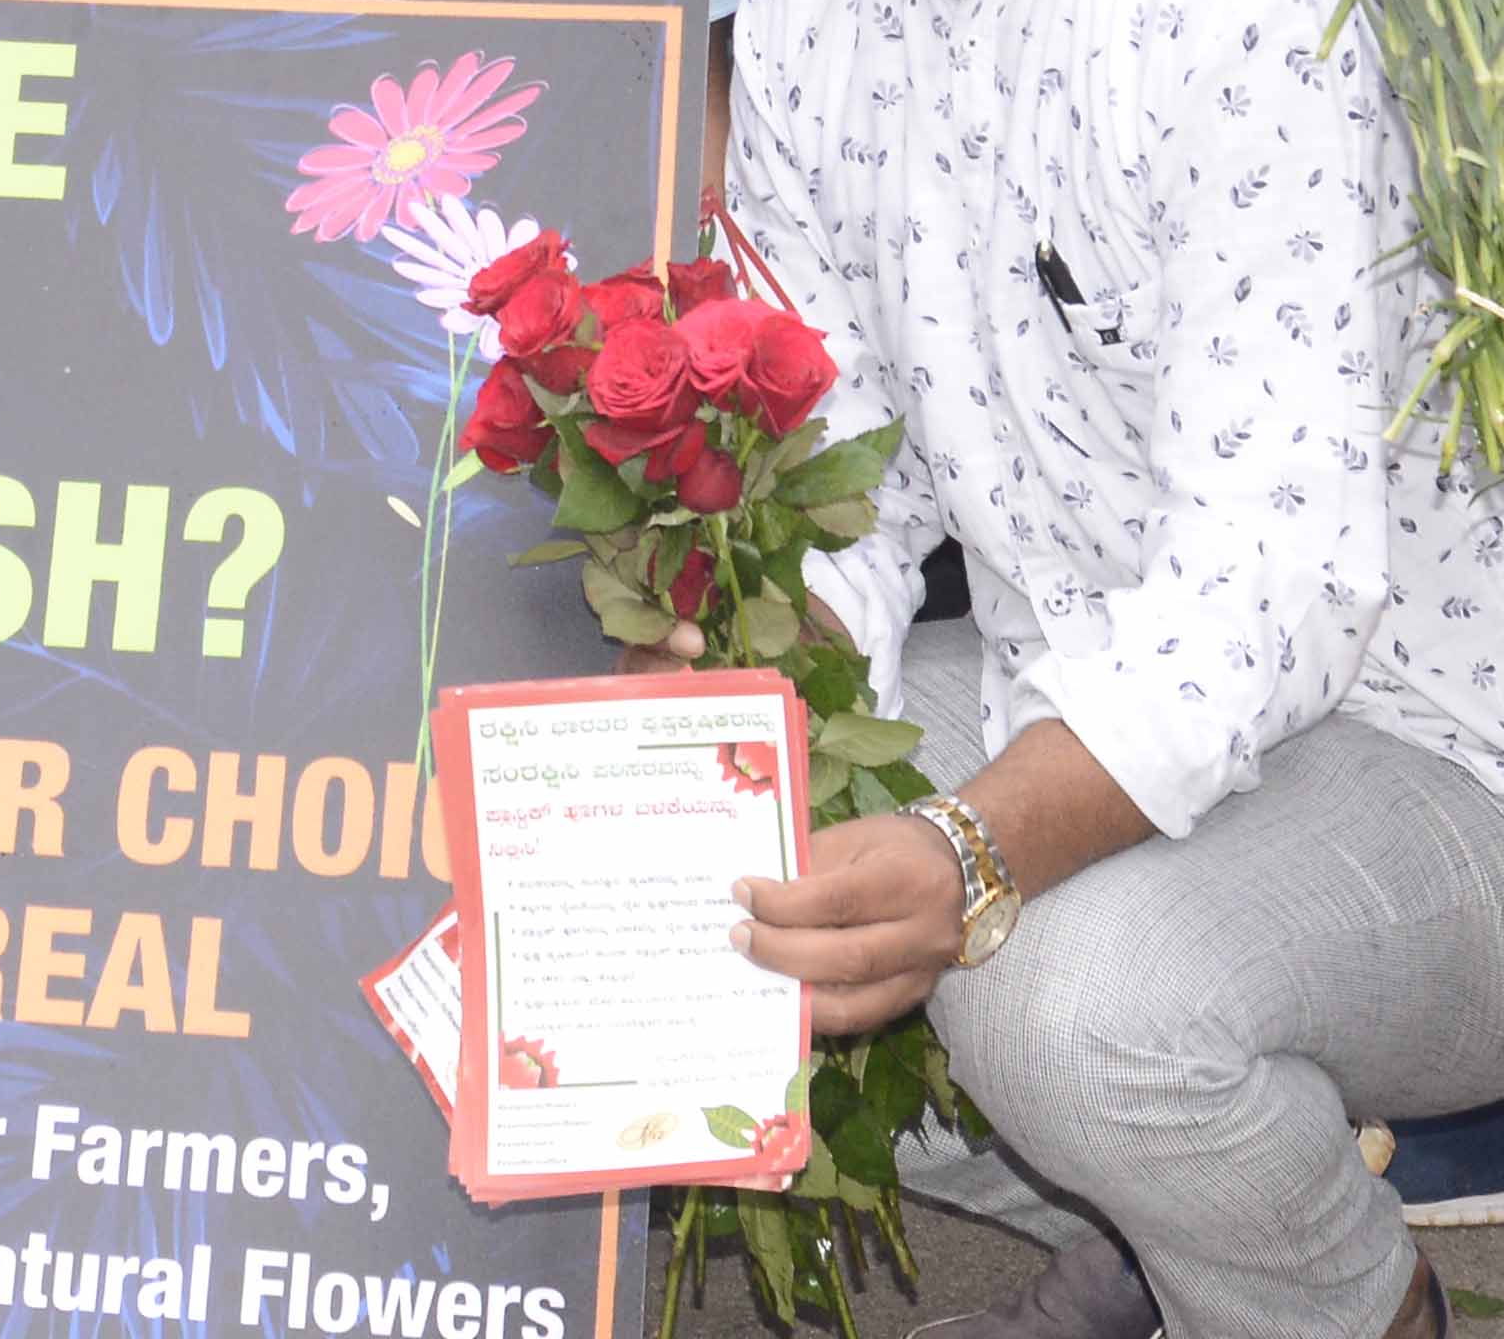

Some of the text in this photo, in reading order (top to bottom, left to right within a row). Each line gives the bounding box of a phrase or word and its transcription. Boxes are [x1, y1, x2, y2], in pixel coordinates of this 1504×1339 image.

[115, 745, 455, 884] CHOI
[31, 1104, 392, 1222] Farmers,
[240, 1248, 567, 1339] Flowers
